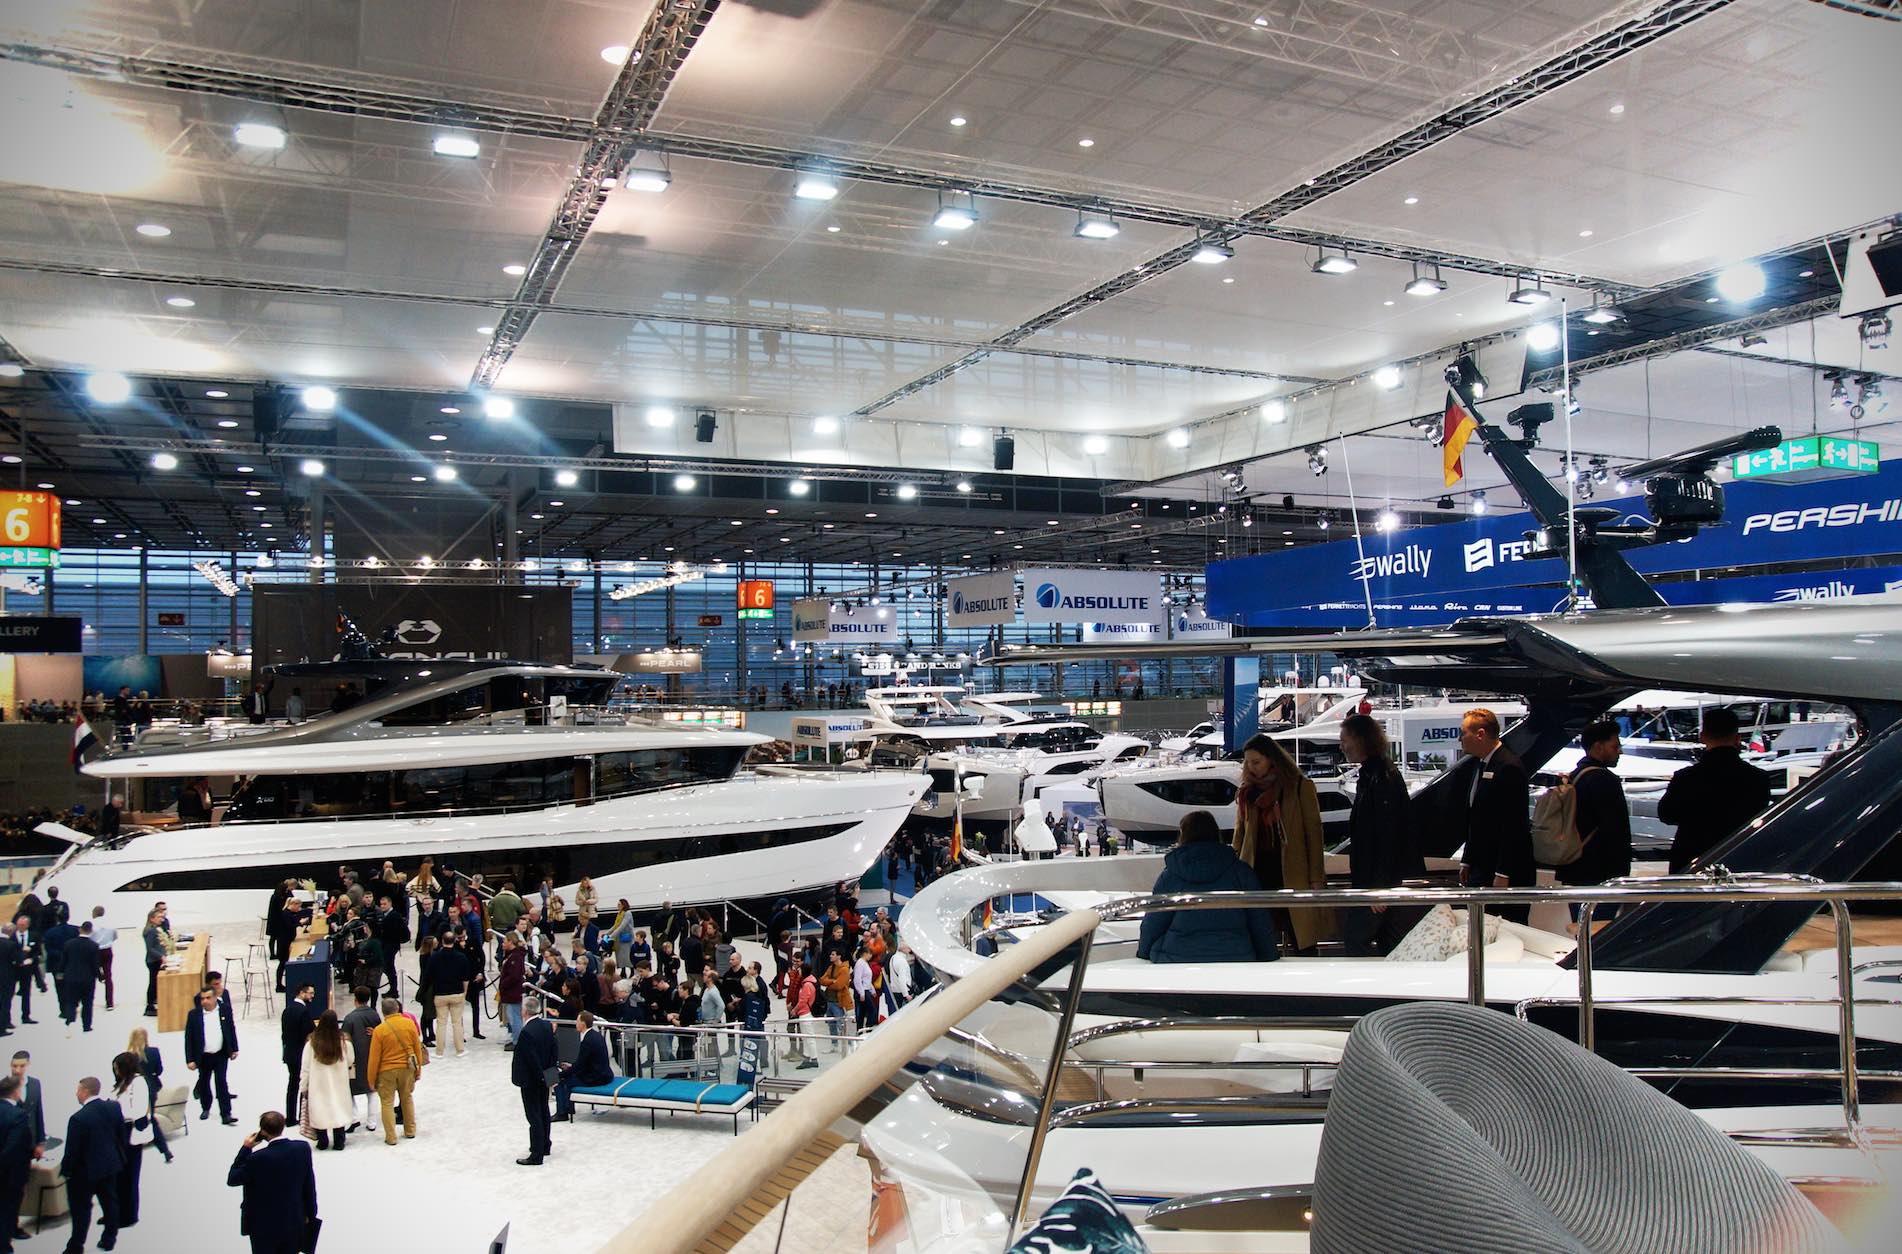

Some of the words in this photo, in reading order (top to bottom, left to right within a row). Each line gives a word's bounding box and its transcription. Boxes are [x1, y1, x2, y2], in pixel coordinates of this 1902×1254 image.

[5, 508, 30, 542] 6
[1375, 544, 1432, 578] wally
[755, 589, 765, 606] 6
[963, 597, 1008, 613] ABSOLUTE
[1061, 596, 1148, 609] ABSOLUTE
[1105, 623, 1160, 632] ABSOLUTE
[1188, 622, 1226, 632] ABSOLUTE
